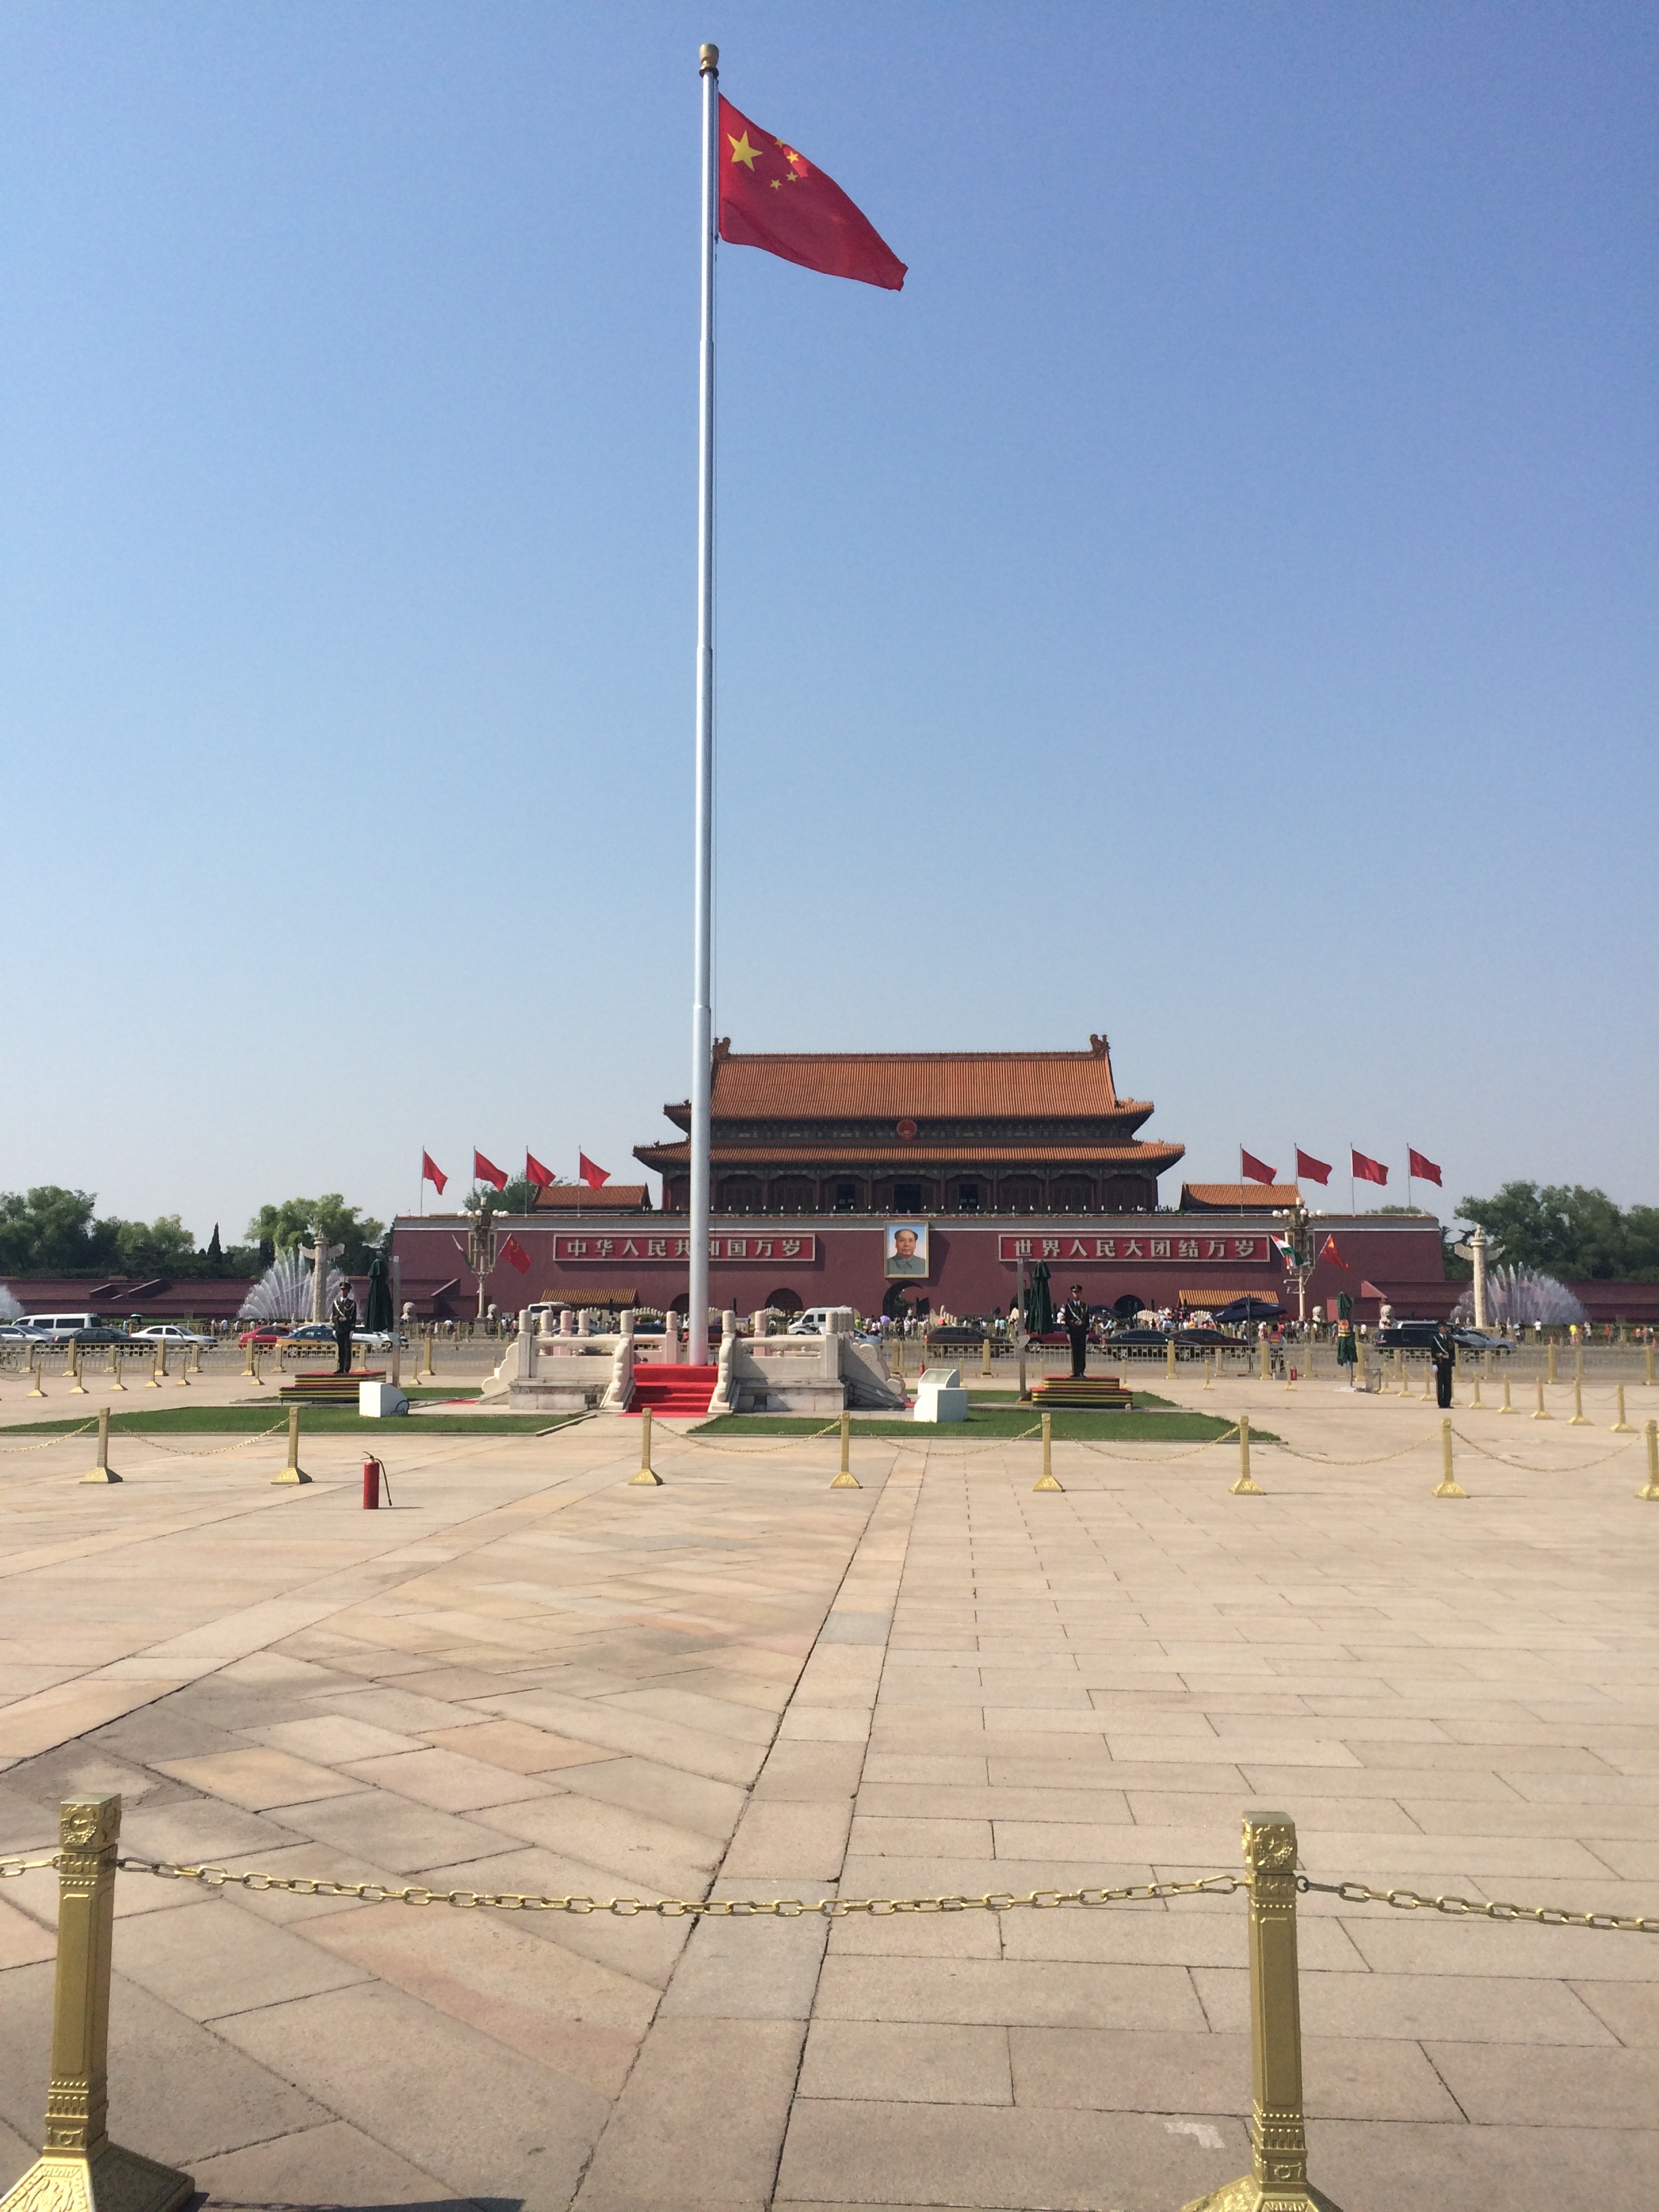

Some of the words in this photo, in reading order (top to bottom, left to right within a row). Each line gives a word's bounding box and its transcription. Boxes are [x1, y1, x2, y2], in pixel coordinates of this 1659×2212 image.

[1013, 1239, 1255, 1256] 世界人民大团结万岁
